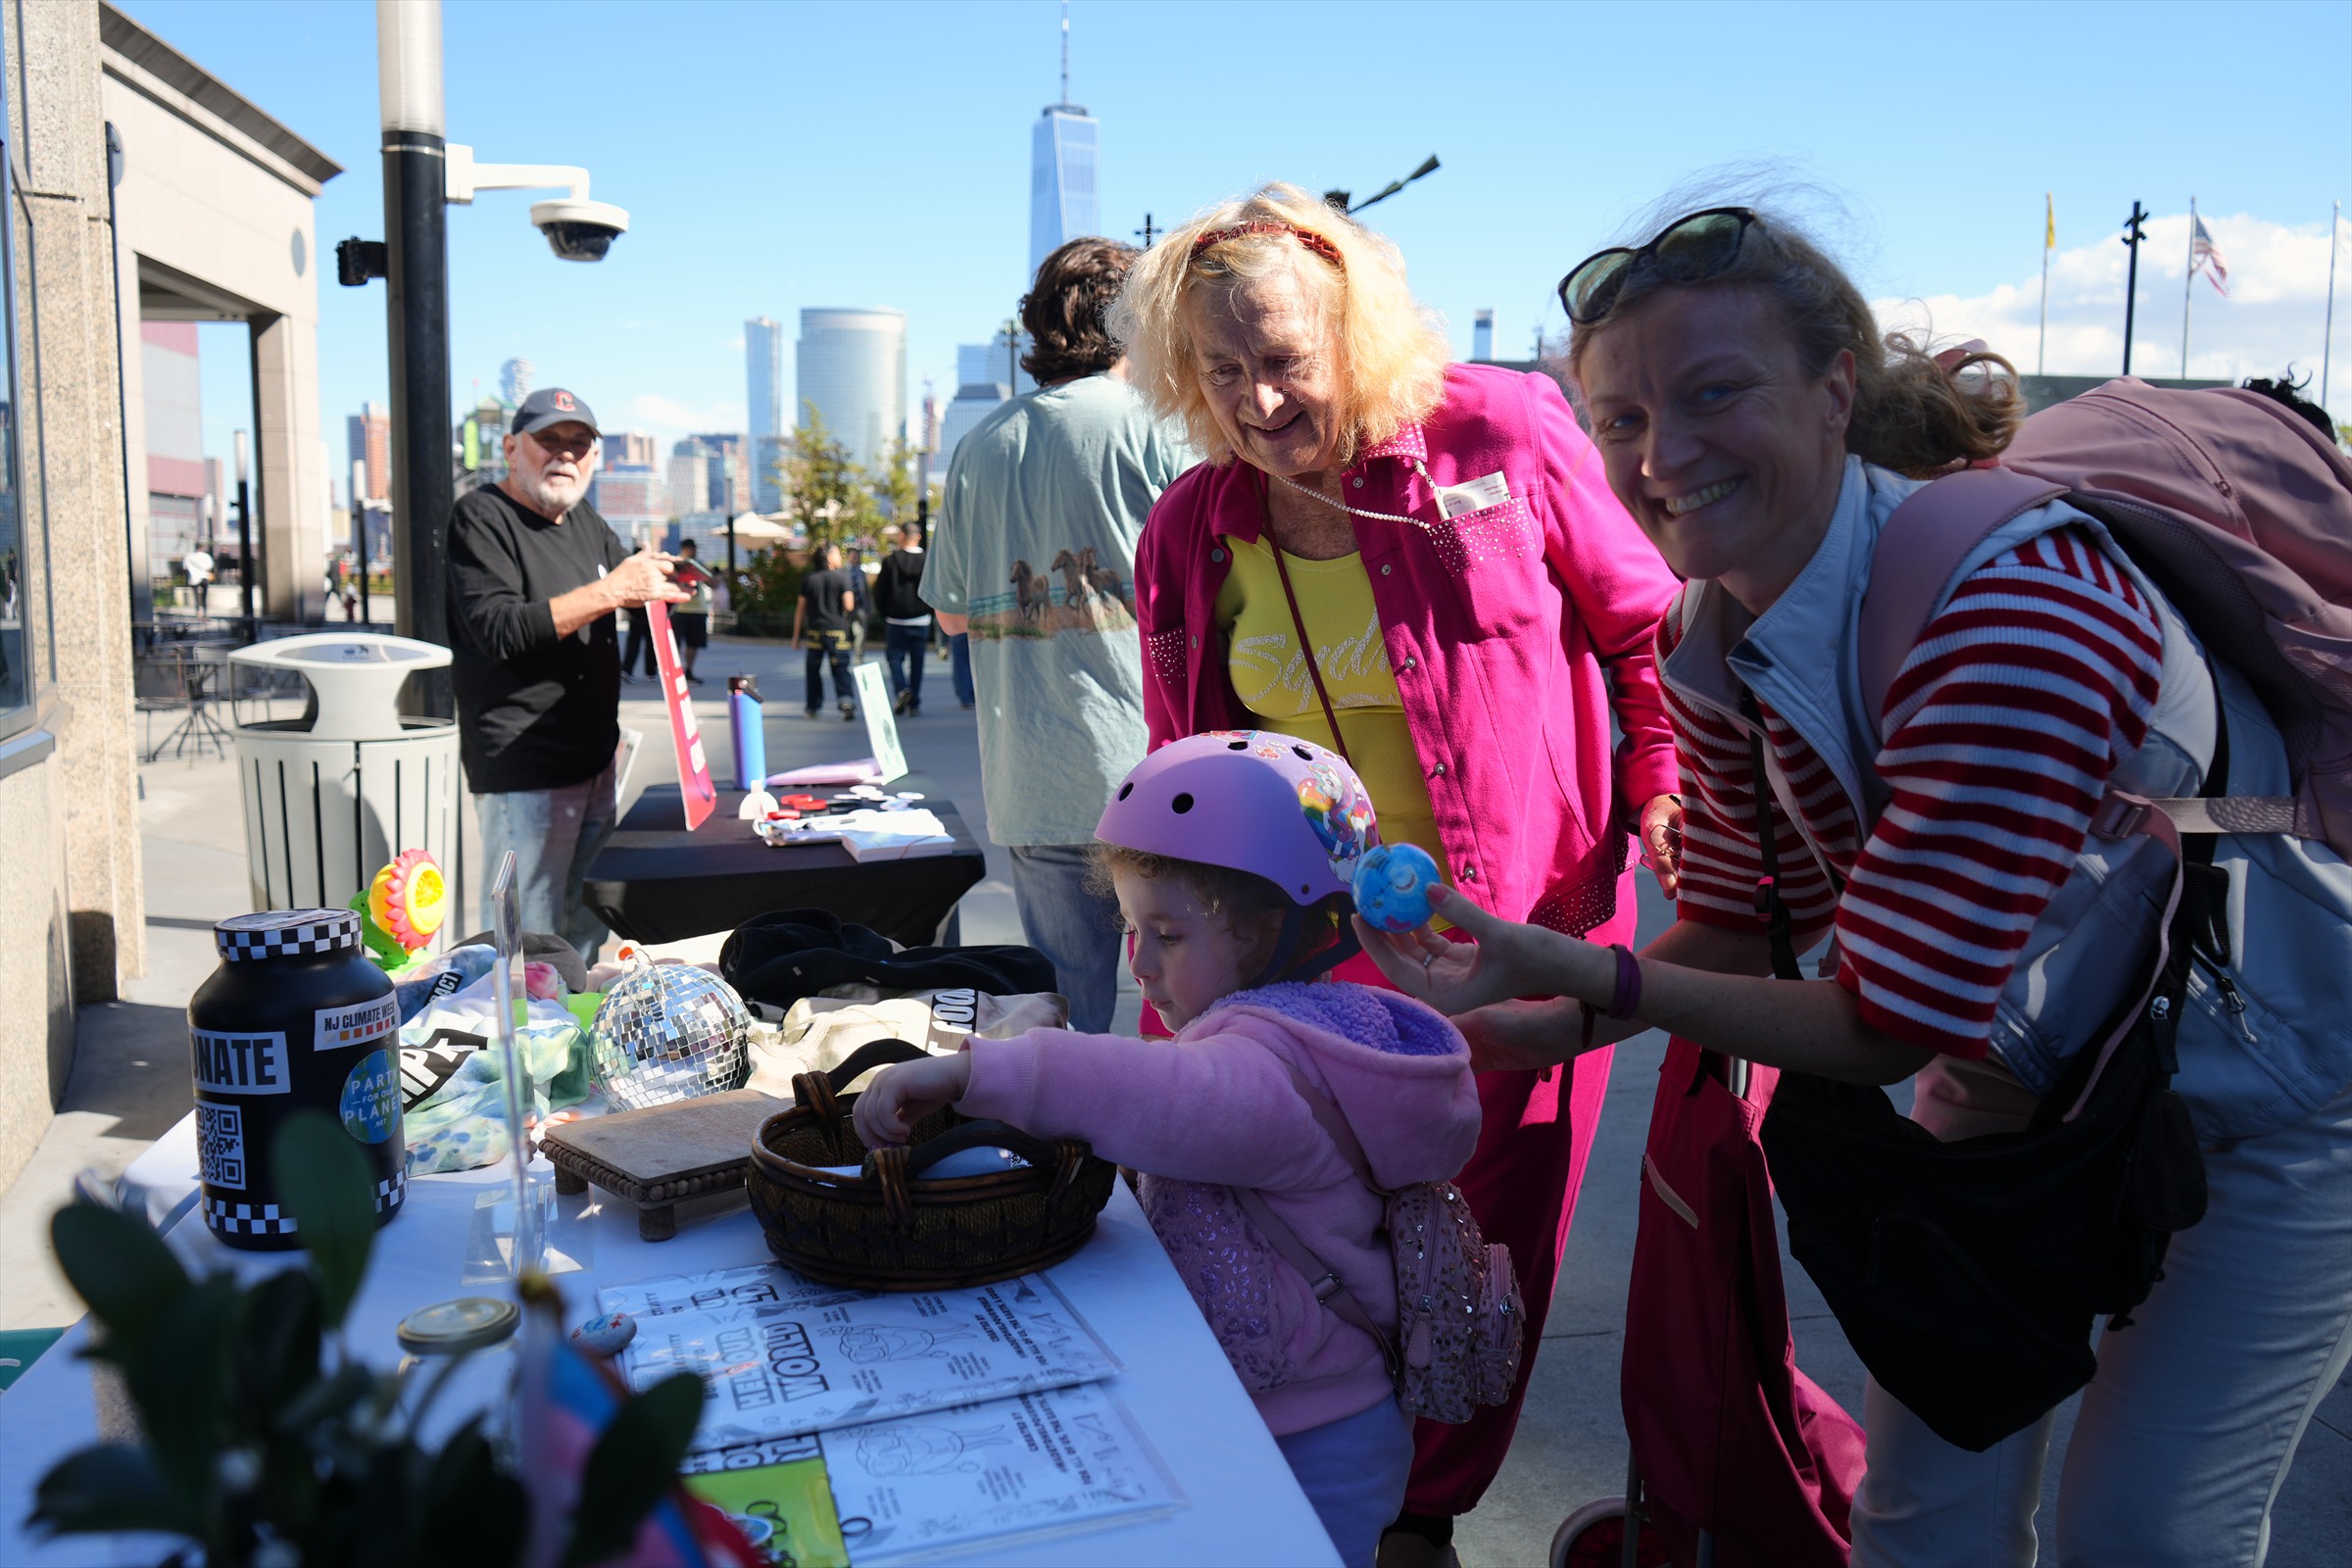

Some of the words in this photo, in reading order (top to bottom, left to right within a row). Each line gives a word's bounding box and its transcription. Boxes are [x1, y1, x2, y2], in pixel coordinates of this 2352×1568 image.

[324, 1016, 339, 1031] NJ
[343, 1006, 380, 1029] CLIMATE
[351, 1067, 397, 1095] PARTY
[344, 1093, 401, 1125] PLANET
[363, 1092, 379, 1103] FOR
[690, 1287, 729, 1311] UR
[980, 1319, 1000, 1343] CREATED
[714, 1327, 760, 1364] OUR
[760, 1321, 830, 1403] WORLD
